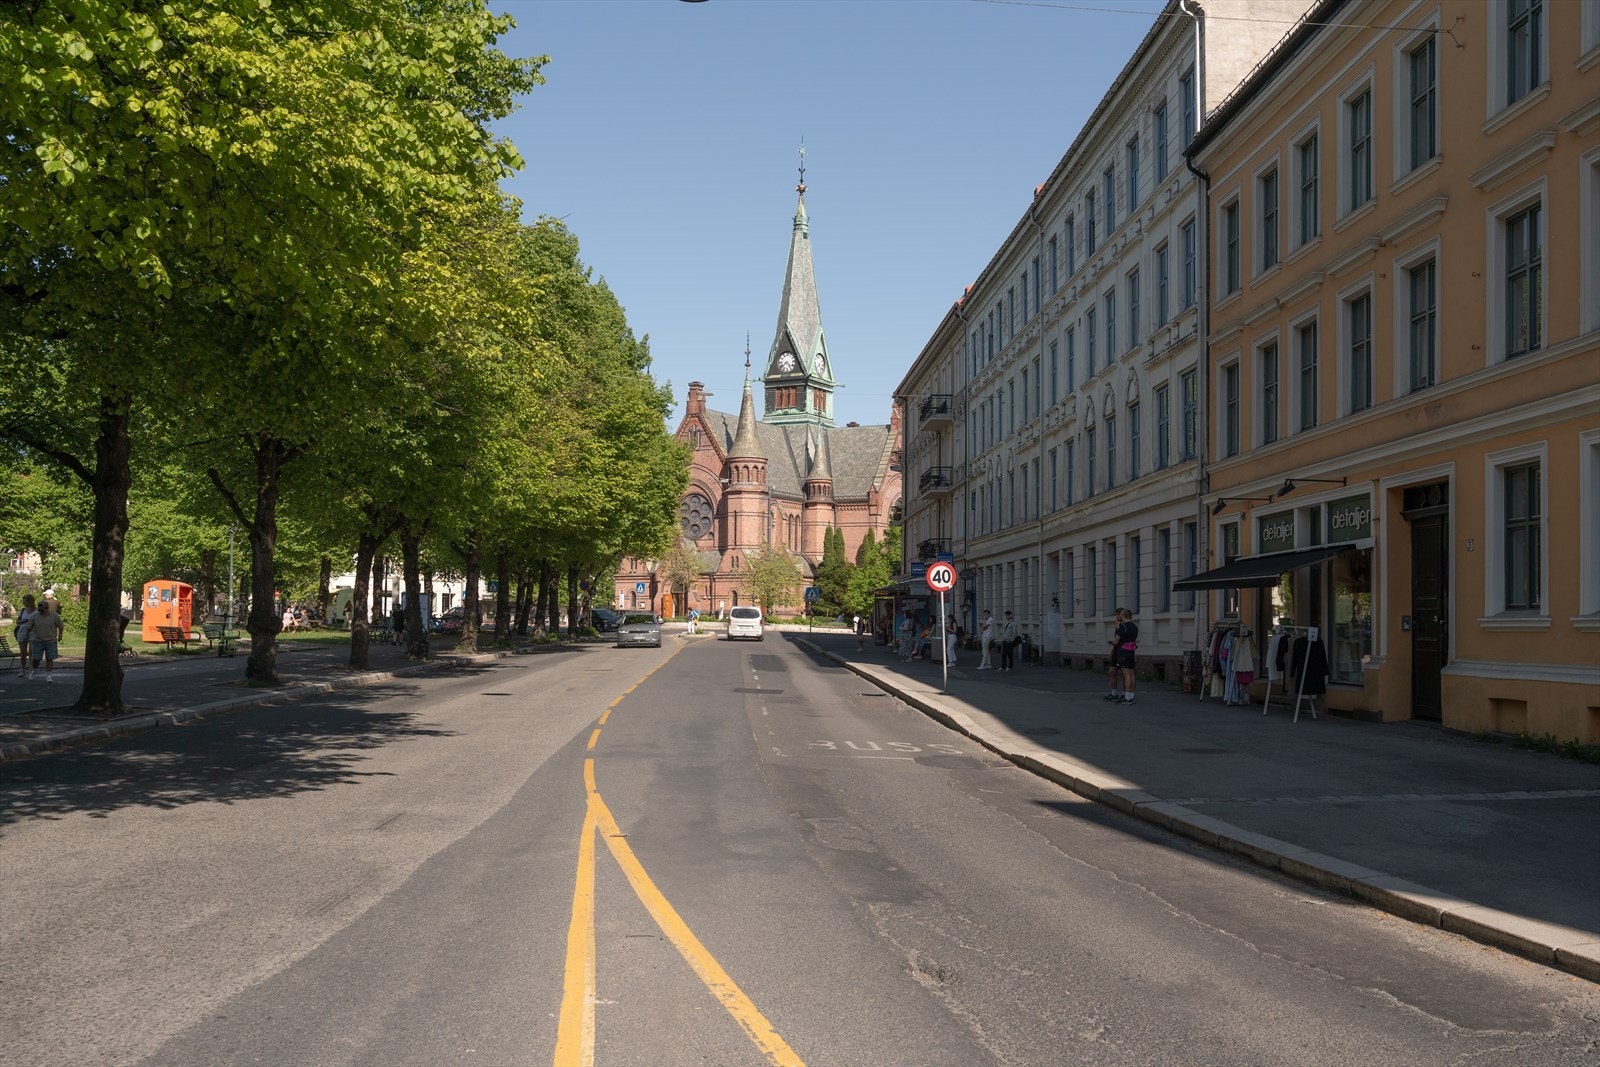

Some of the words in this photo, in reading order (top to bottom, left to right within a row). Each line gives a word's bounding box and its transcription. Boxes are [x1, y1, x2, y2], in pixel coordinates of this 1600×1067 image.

[1332, 508, 1370, 530] detaljer
[1263, 521, 1294, 541] detaljer
[932, 570, 951, 583] 40
